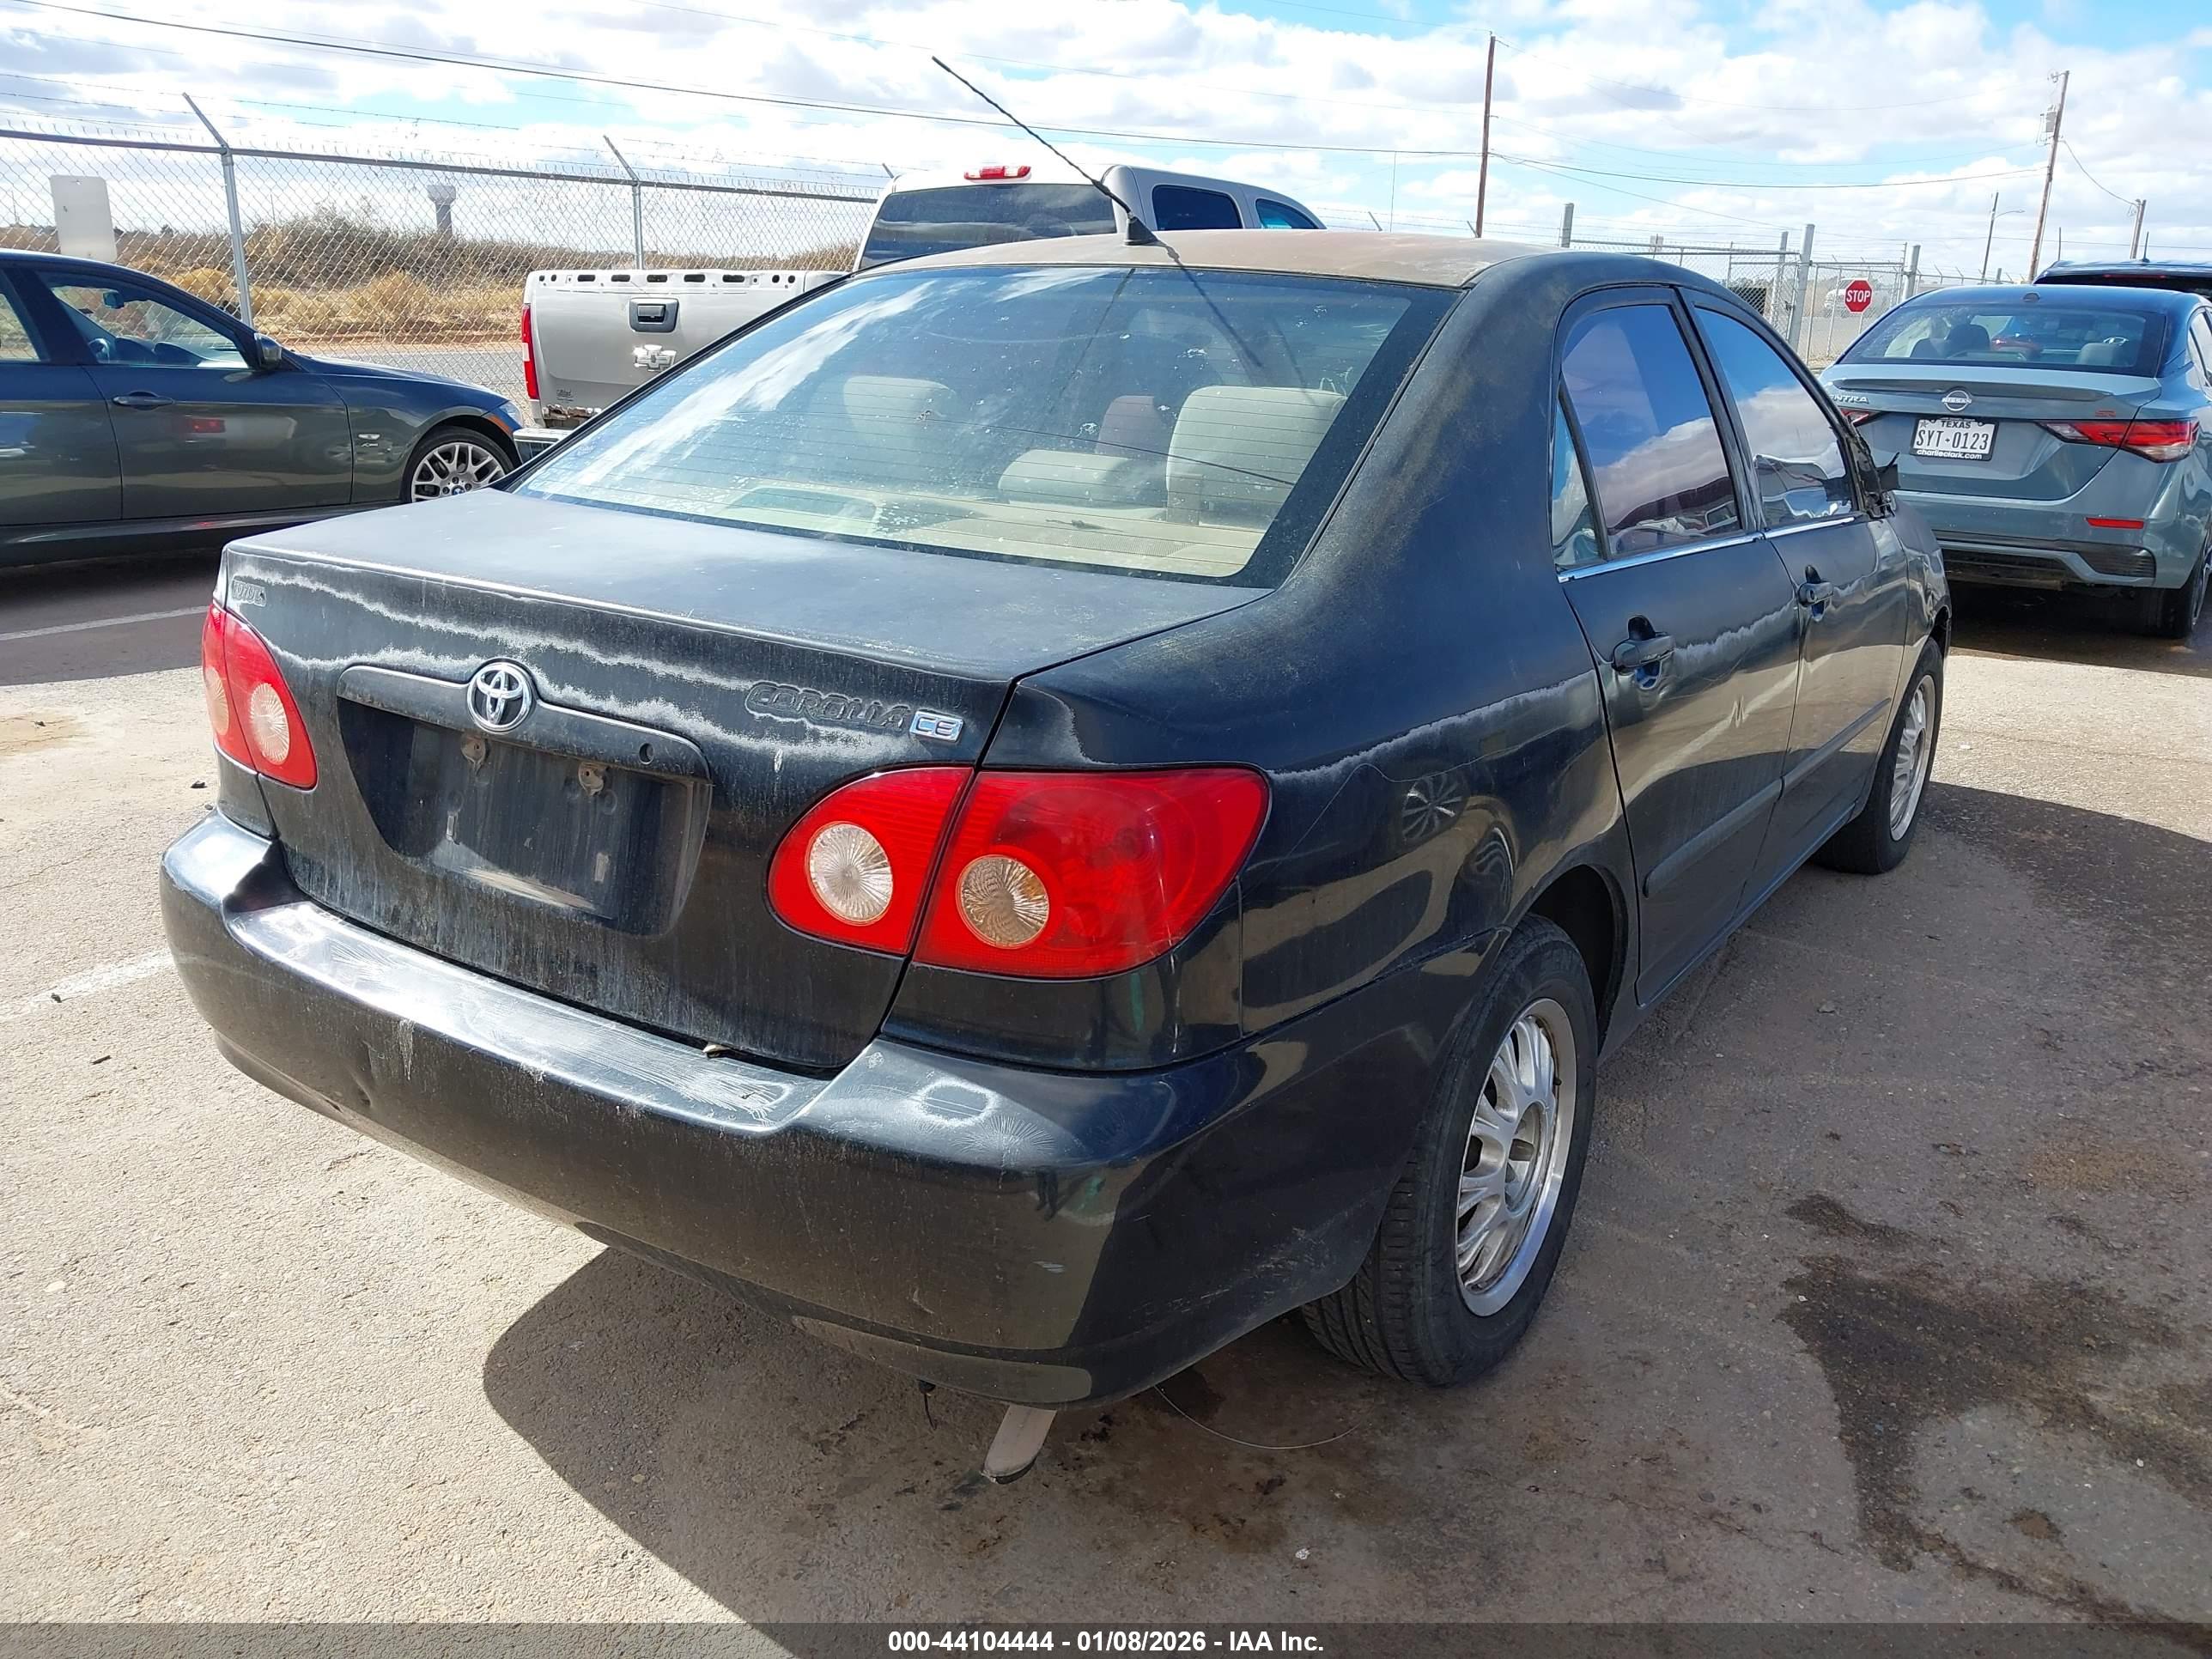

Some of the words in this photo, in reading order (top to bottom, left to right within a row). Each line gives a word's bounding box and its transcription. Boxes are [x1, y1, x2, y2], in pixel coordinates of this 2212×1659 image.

[1846, 289, 1871, 303] STOP
[1829, 394, 1869, 404] ENTRA
[1941, 420, 1972, 429] TEXAS
[1916, 448, 1983, 460] charlieclark.com
[750, 682, 911, 732] COROLLA
[915, 715, 958, 738] CE
